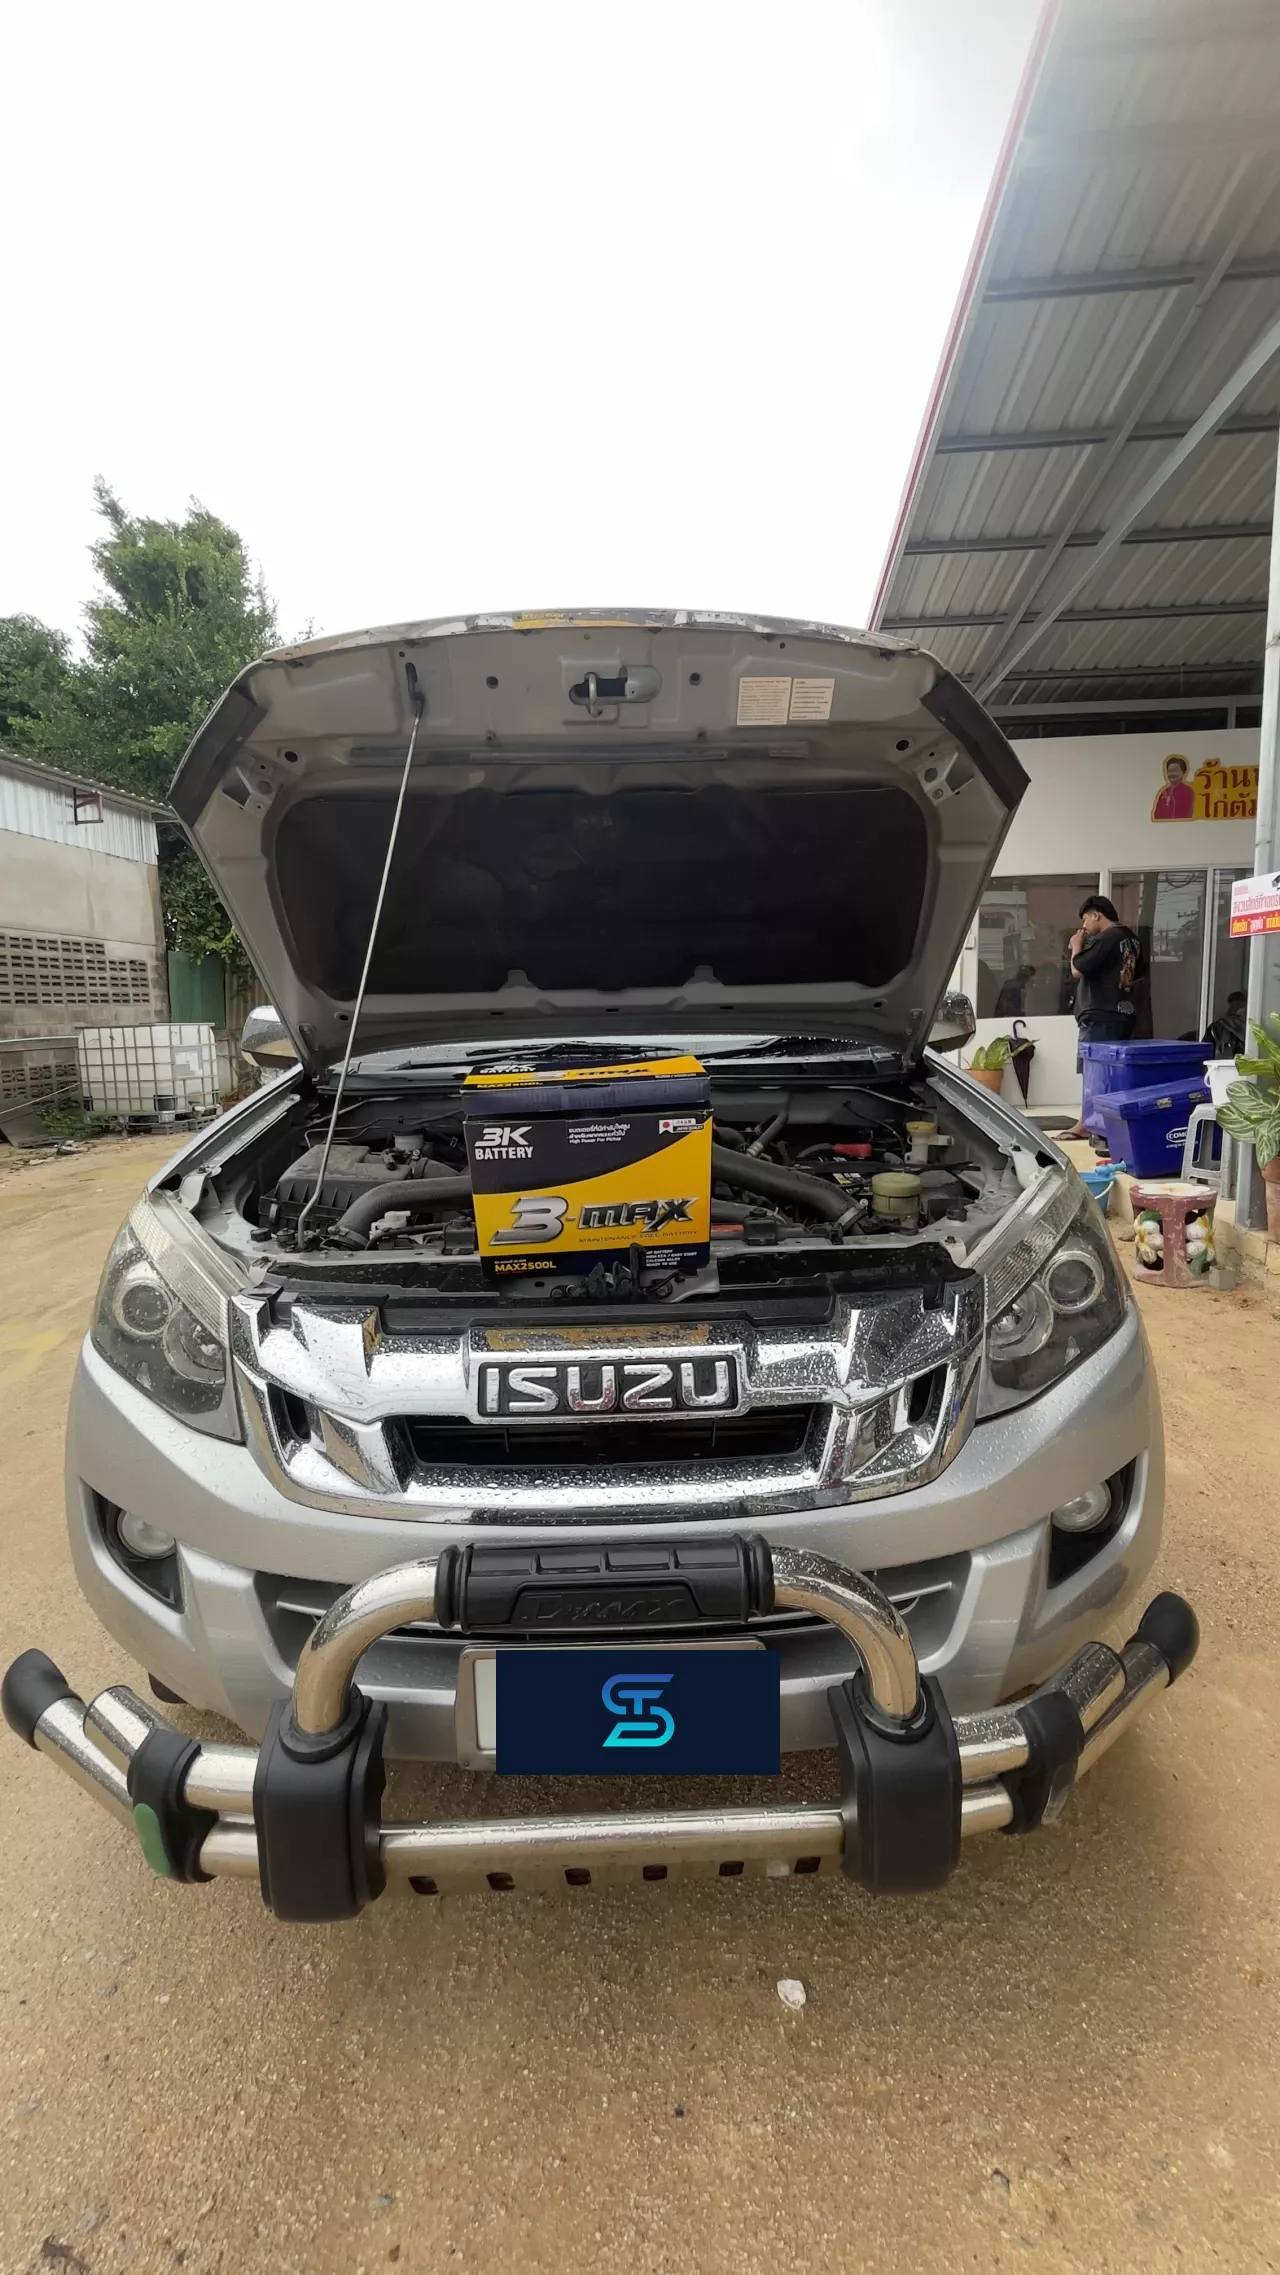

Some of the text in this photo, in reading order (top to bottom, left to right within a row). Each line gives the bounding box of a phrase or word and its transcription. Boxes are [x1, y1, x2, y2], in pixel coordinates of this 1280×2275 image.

[474, 1126, 533, 1147] 3K
[475, 1146, 534, 1160] BATTERY
[494, 1261, 557, 1272] MAX2500L
[486, 1361, 728, 1413] ISUZU
